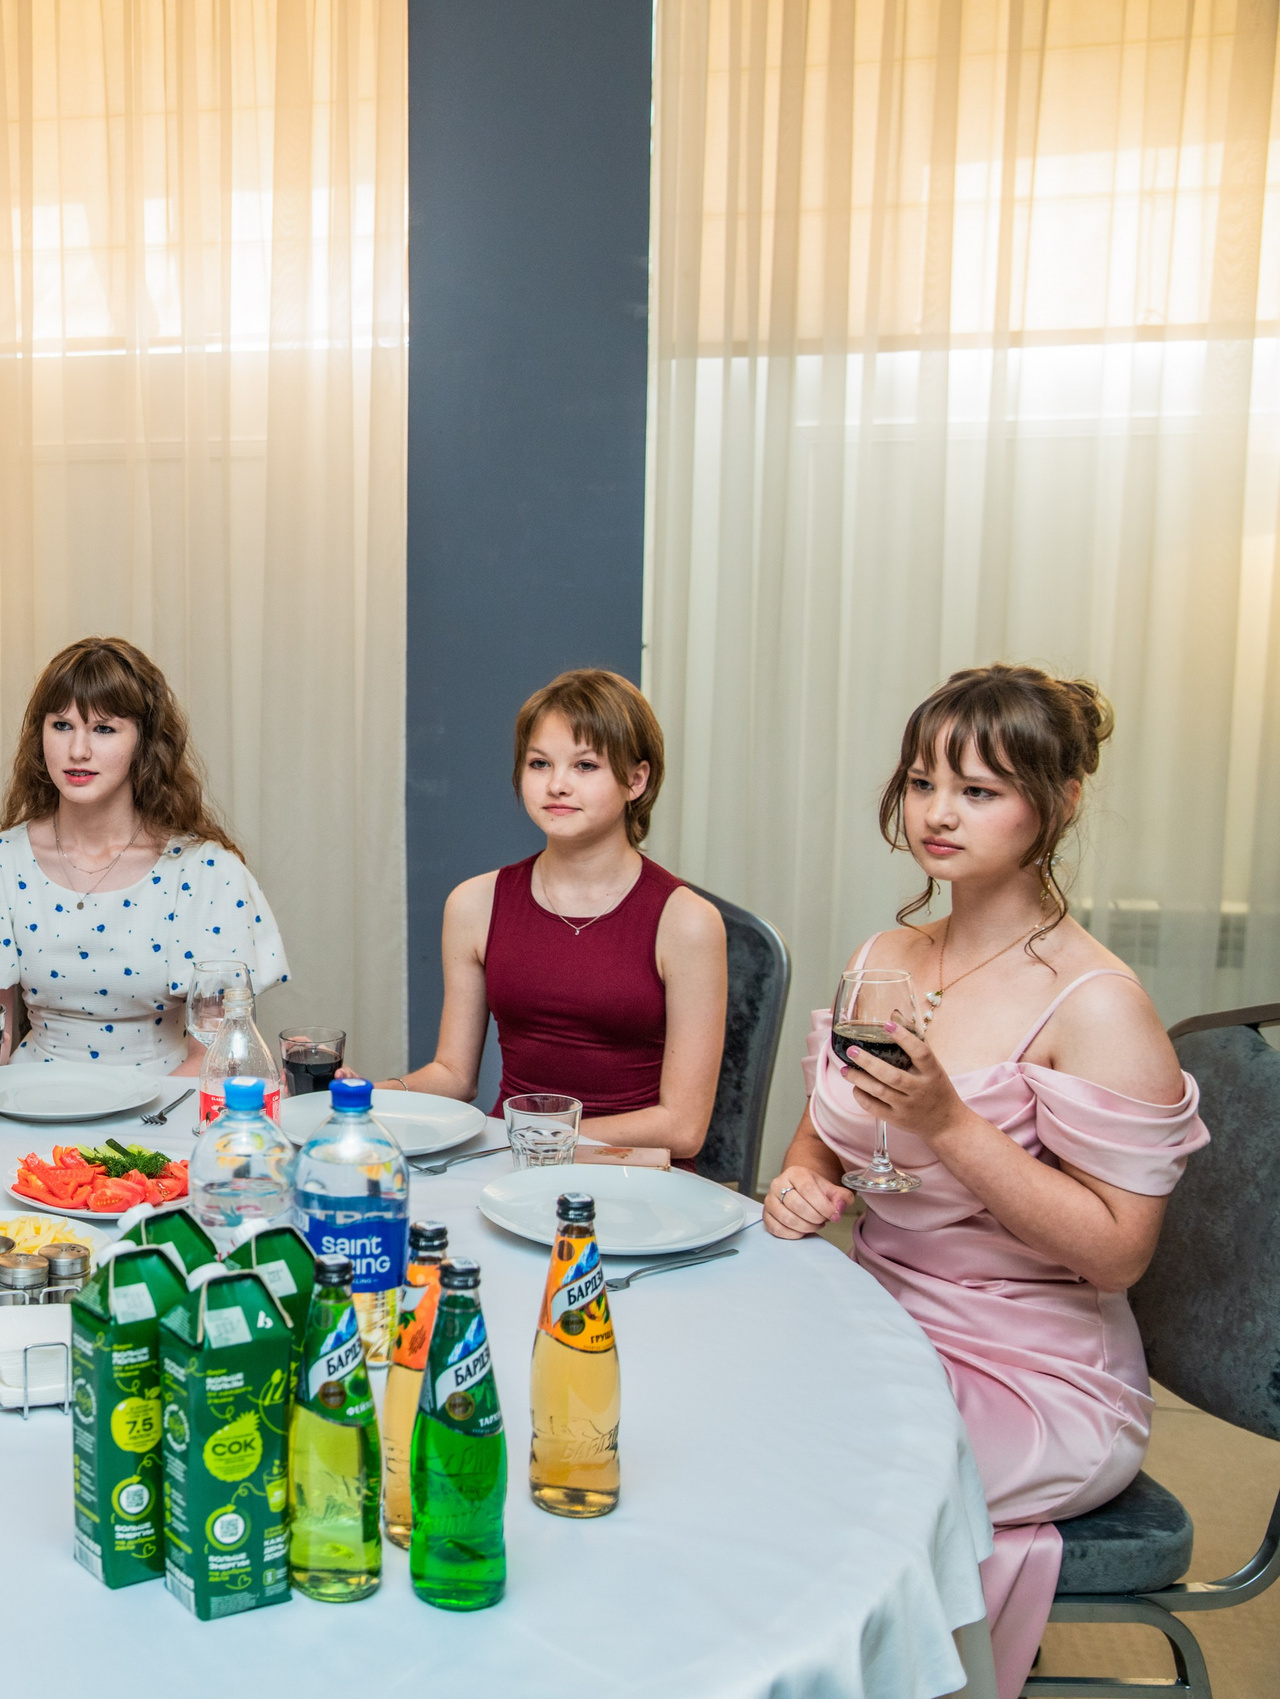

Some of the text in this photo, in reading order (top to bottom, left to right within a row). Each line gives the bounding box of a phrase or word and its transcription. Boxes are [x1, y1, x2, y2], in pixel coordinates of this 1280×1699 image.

[567, 1269, 604, 1307] БАРДЗ
[454, 1345, 490, 1387] БАРДЗ
[126, 1417, 153, 1435] 7.5
[212, 1437, 256, 1456] СОК
